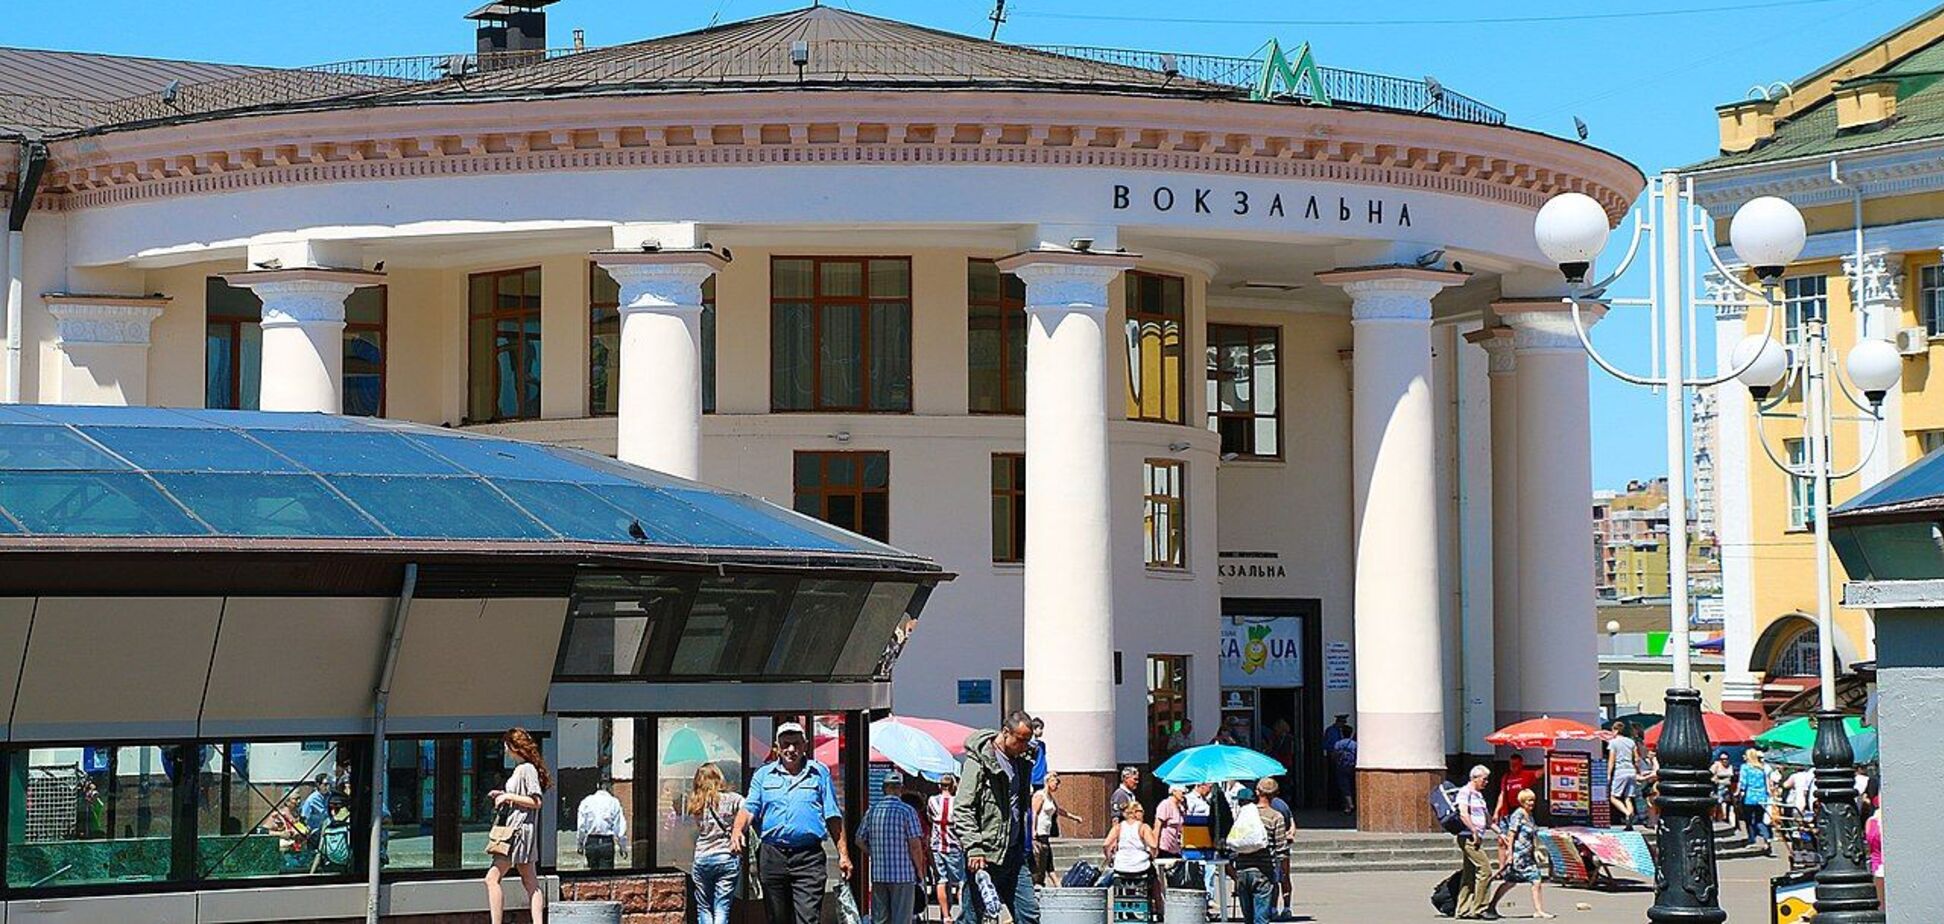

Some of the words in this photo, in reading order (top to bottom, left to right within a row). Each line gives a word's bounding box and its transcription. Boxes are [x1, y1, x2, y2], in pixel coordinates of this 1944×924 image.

[1250, 37, 1332, 106] М
[1113, 185, 1411, 227] ВОКЗАЛЬНА
[1271, 639, 1297, 658] UA
